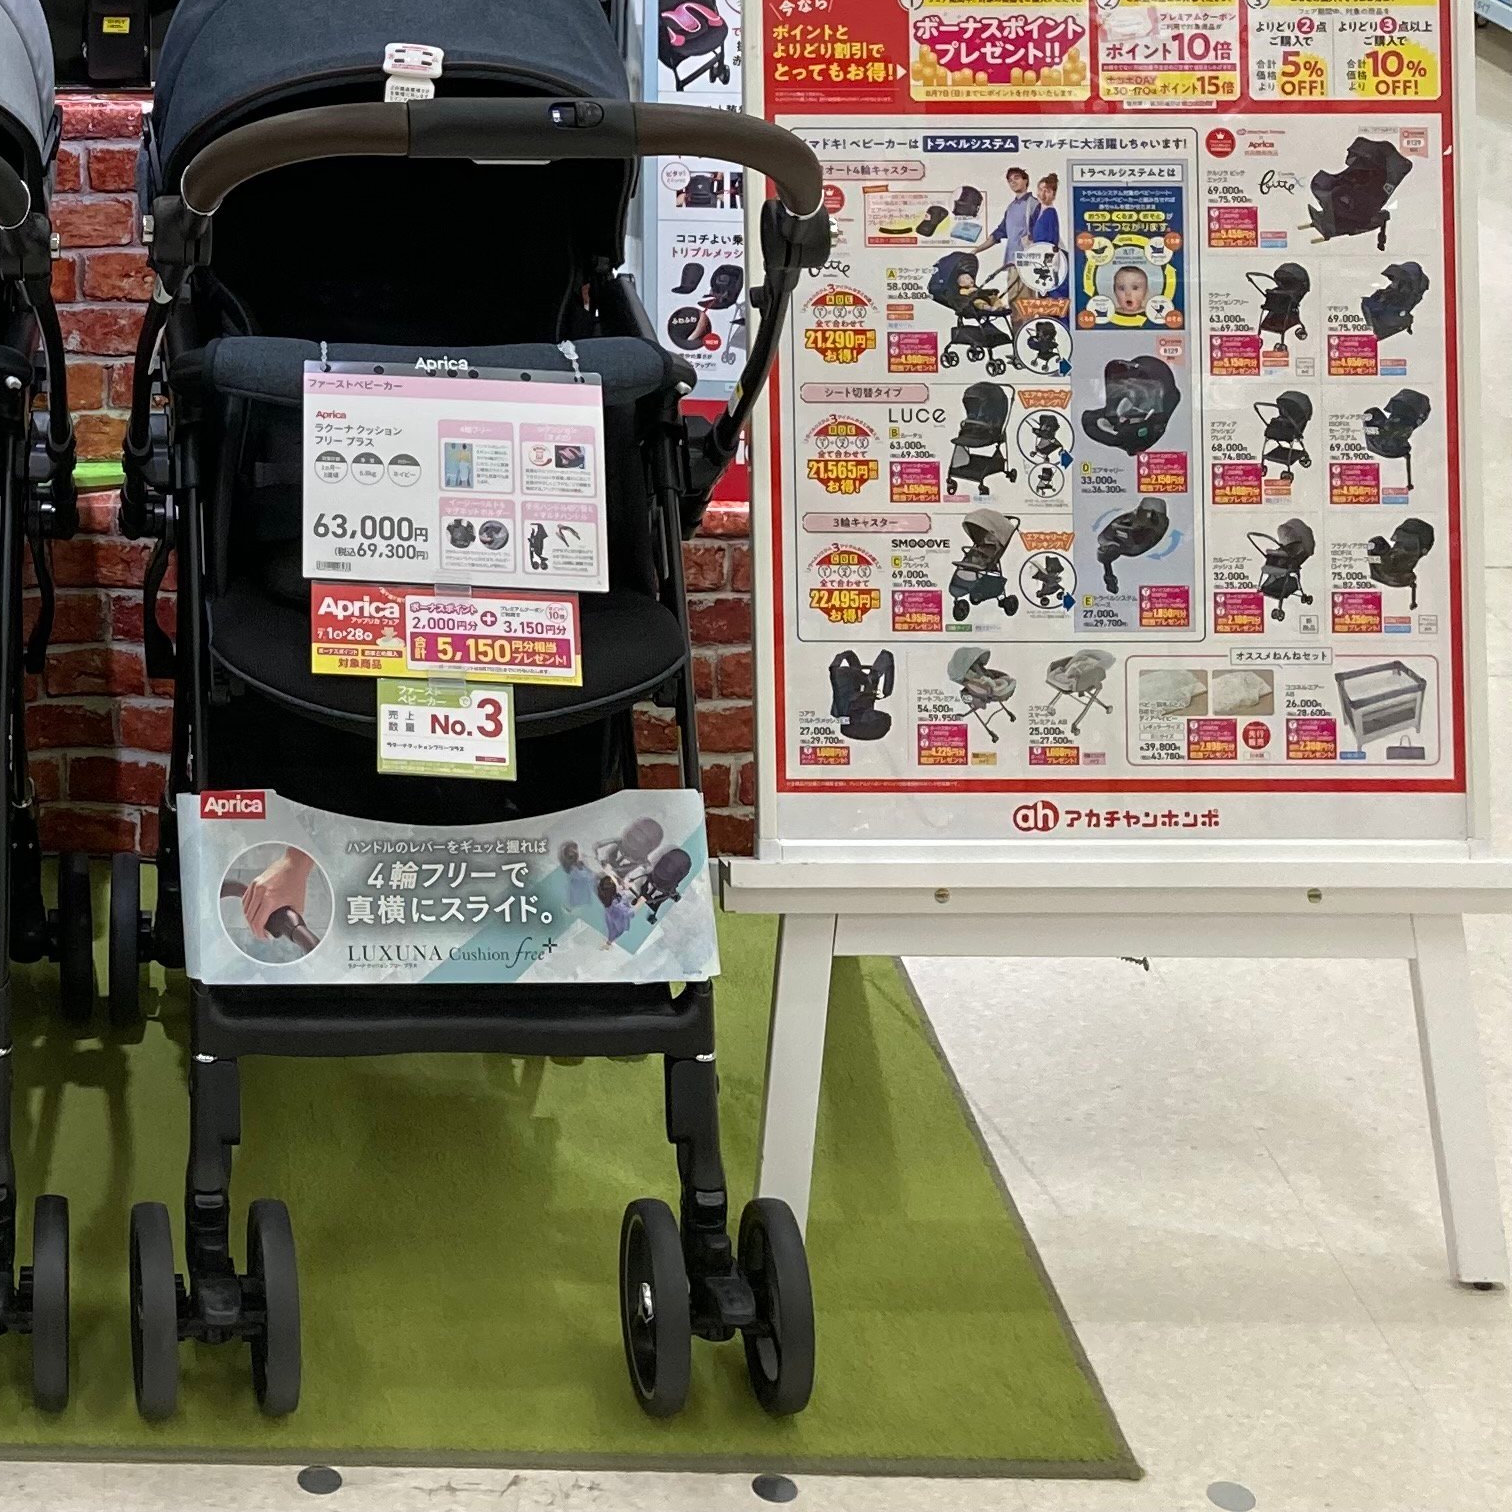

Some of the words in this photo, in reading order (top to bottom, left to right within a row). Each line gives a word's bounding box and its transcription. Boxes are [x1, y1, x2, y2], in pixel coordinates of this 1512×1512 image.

[772, 24, 849, 40] ポイントと
[915, 15, 1085, 40] ボーナスポイント
[1269, 36, 1314, 47] ご購入で
[1363, 36, 1407, 47] ご購入で
[772, 41, 885, 60] よりどり割引で
[1366, 50, 1427, 77] 10%
[1280, 80, 1326, 96] OFF!
[1374, 80, 1419, 96] OFF!
[849, 138, 919, 151] ベビーカーは
[925, 137, 1017, 151] トラベルシステム
[1078, 166, 1176, 178] トラベルシステムとは
[414, 355, 469, 371] Aprica
[307, 378, 403, 391] ファーストベビーカー
[823, 387, 903, 400] シート切替タイプ
[315, 409, 347, 420] Aprica
[314, 422, 354, 434] ラクーナ
[356, 424, 403, 436] クッション
[312, 512, 429, 543] 63,000円
[832, 516, 899, 529] 3輪キャスター
[317, 595, 401, 622] Aprica
[411, 616, 478, 632] 2,000円分
[503, 620, 567, 635] 3,150円分
[1235, 650, 1328, 662] オススメねんねセット
[203, 795, 263, 815] Aprica
[1065, 808, 1220, 827] アカチャンホンポ
[346, 839, 547, 856] ハンドルのレバーをギュッと握れば
[366, 861, 529, 890] 4輪フリーで
[345, 894, 554, 926] 真横にスライド。
[347, 944, 443, 961] LUXUNA
[449, 945, 511, 962] Cushion
